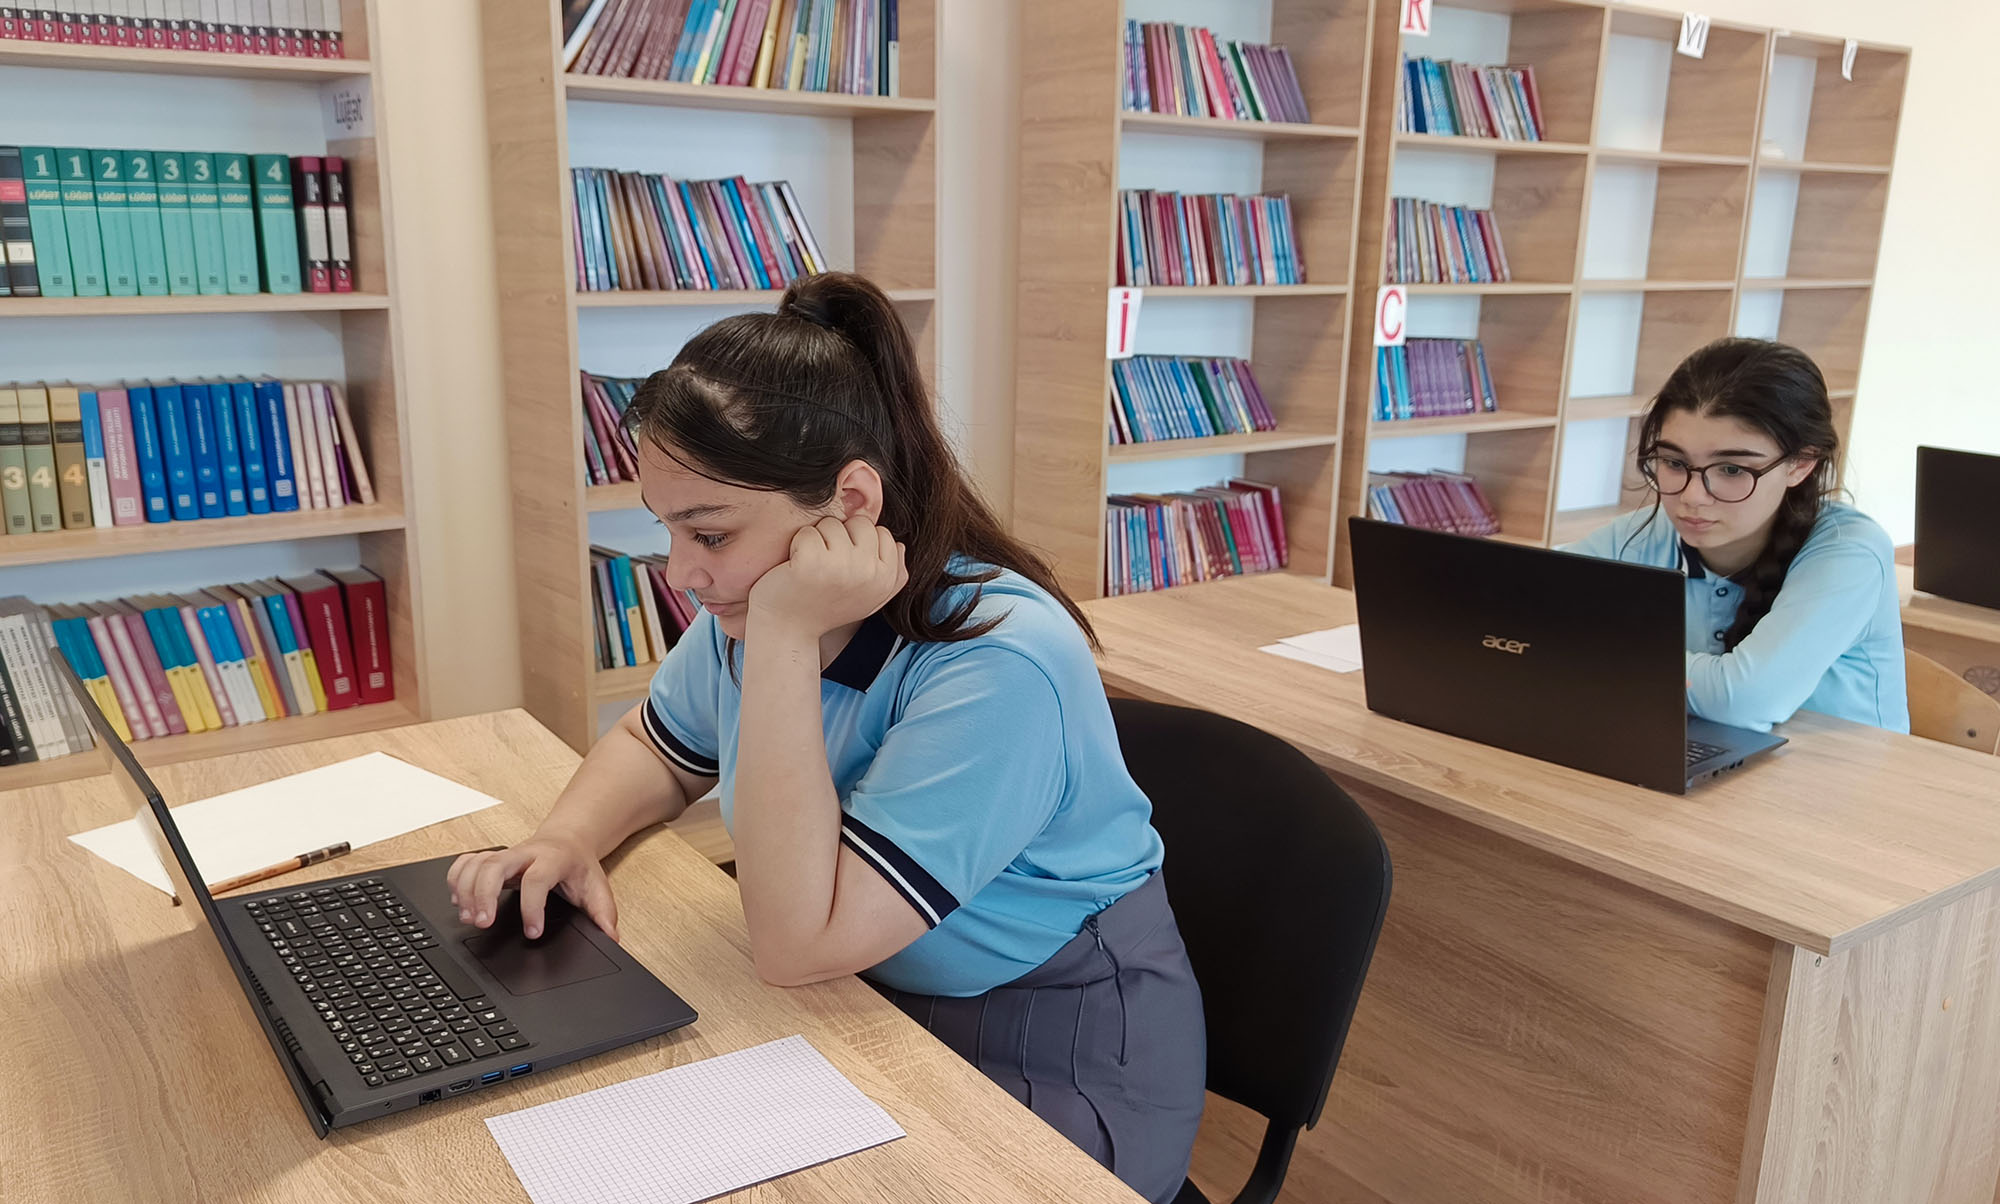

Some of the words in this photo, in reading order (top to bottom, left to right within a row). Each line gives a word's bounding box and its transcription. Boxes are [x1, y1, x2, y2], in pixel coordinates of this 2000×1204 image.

[33, 154, 50, 177] 1
[68, 155, 85, 178] 1
[101, 156, 119, 179] 2
[132, 157, 149, 179] 2
[163, 158, 179, 181] 3
[194, 159, 210, 181] 3
[225, 160, 242, 181] 4
[266, 161, 283, 182] 4
[1379, 289, 1403, 341] C
[3, 466, 24, 490] 3
[31, 466, 53, 489] 4
[63, 463, 84, 487] 4
[1481, 634, 1531, 655] acer
